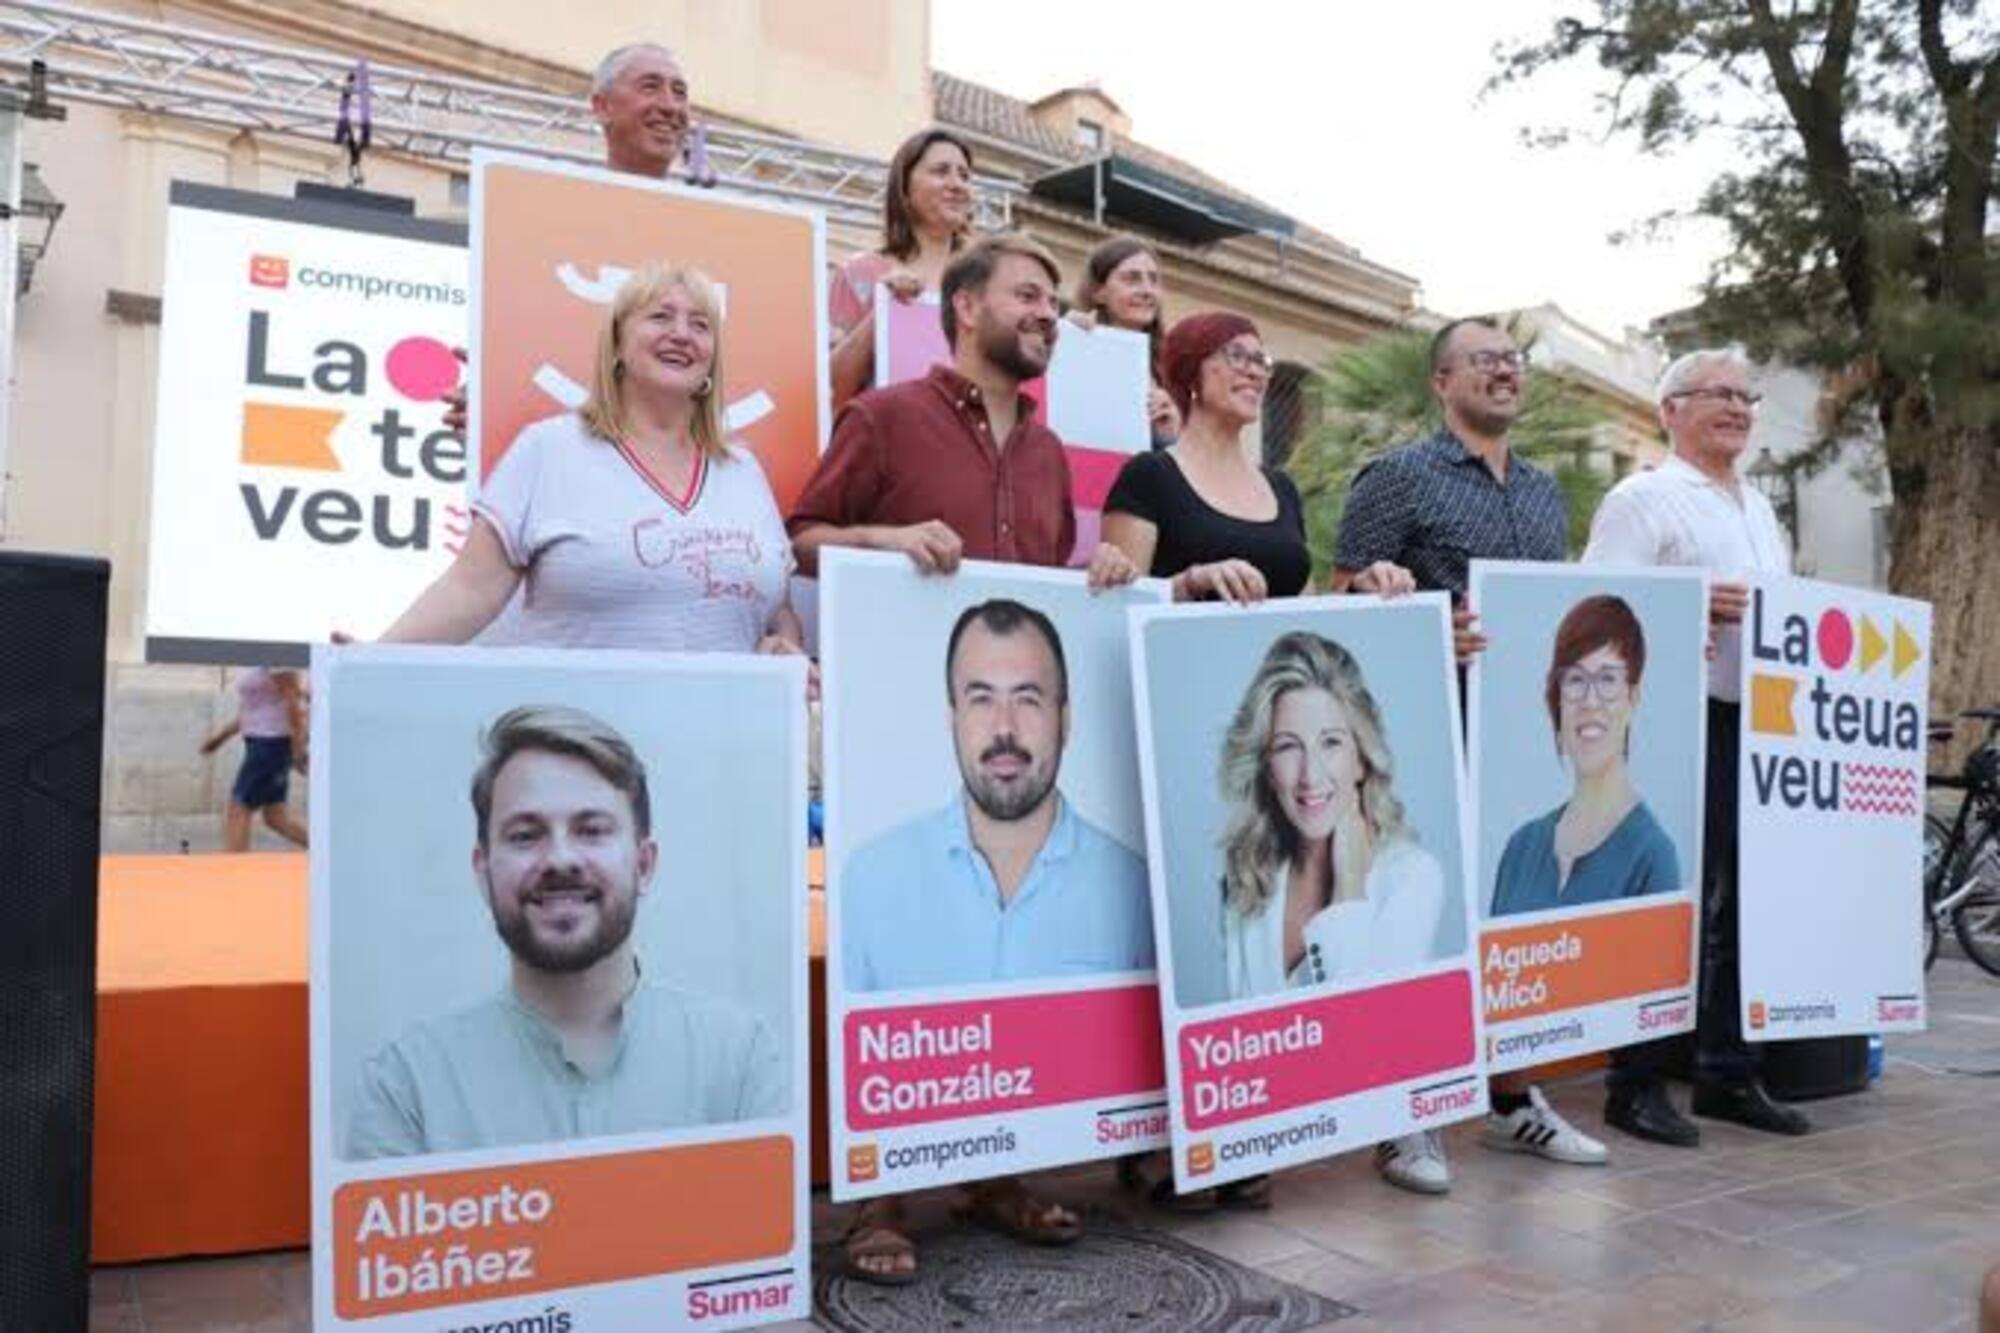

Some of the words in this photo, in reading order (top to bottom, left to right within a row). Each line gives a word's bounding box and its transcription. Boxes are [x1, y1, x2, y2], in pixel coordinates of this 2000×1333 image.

[245, 309, 368, 396] La
[239, 483, 431, 552] veu
[1752, 587, 1810, 667] La
[1811, 677, 1920, 751] teua
[1750, 752, 1840, 811] veu
[1483, 974, 1548, 1012] Micó
[1636, 1005, 1689, 1031] Sumar
[859, 1013, 993, 1064] Nahuel
[1188, 1015, 1323, 1071] Yolanda
[860, 1062, 1034, 1116] González
[1193, 1077, 1269, 1117] Díaz
[1409, 1086, 1478, 1120] Sumar
[884, 1125, 1017, 1170] compromís
[1096, 1113, 1169, 1144] Sumar
[1220, 1113, 1338, 1161] compromís
[355, 1183, 553, 1243] Alberto
[358, 1243, 536, 1300] Ibáñez
[687, 1282, 795, 1321] Sumar
